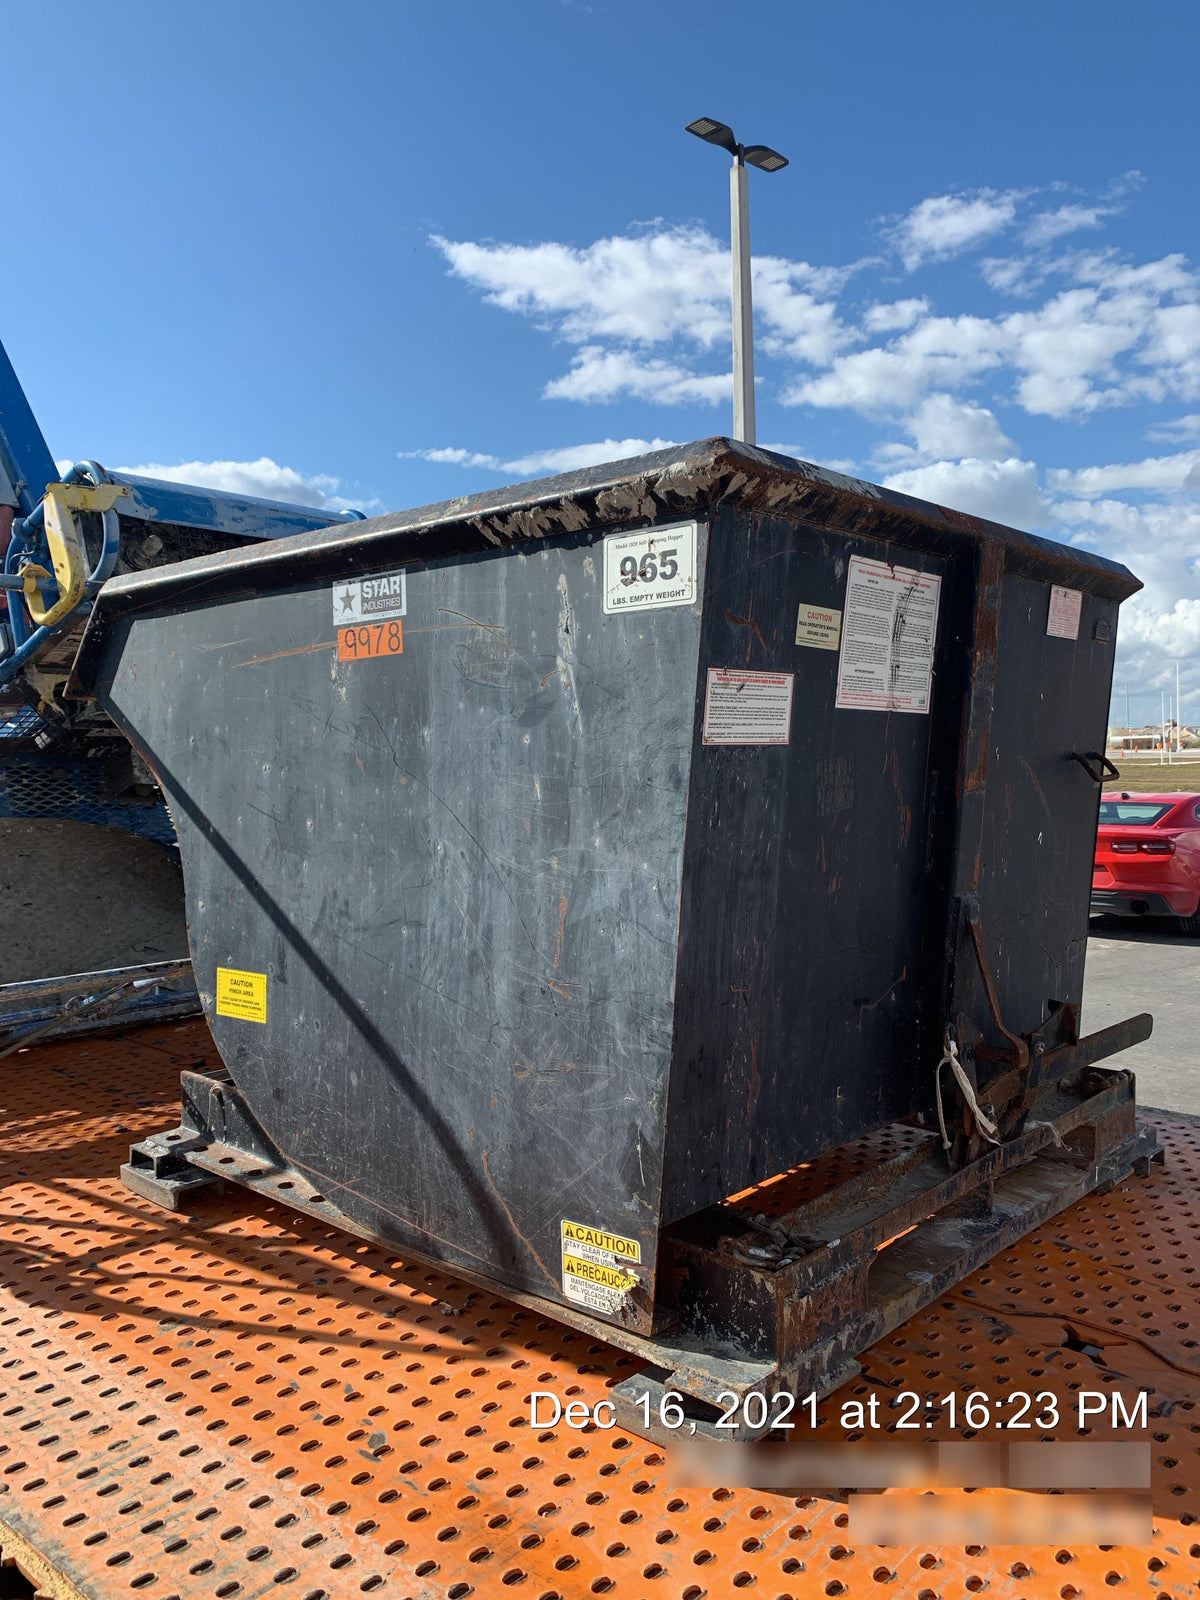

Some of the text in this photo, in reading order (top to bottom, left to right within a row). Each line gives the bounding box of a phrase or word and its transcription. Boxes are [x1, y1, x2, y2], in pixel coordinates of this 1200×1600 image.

[620, 549, 678, 587] 965
[362, 575, 400, 599] STAR
[362, 596, 400, 611] INDUSTRIES
[612, 589, 686, 605] LBS. EMPTY WEIGHT
[807, 611, 832, 622] CAUTION
[344, 621, 401, 657] 9978
[230, 979, 253, 988] CAUTION
[565, 1240, 580, 1250] STAY
[581, 1245, 601, 1257] CLEAR
[602, 1251, 611, 1259] OF
[576, 1227, 636, 1257] CAUTION
[582, 1252, 600, 1263] WHEN
[600, 1259, 619, 1270] USING
[570, 1283, 580, 1293] DEL
